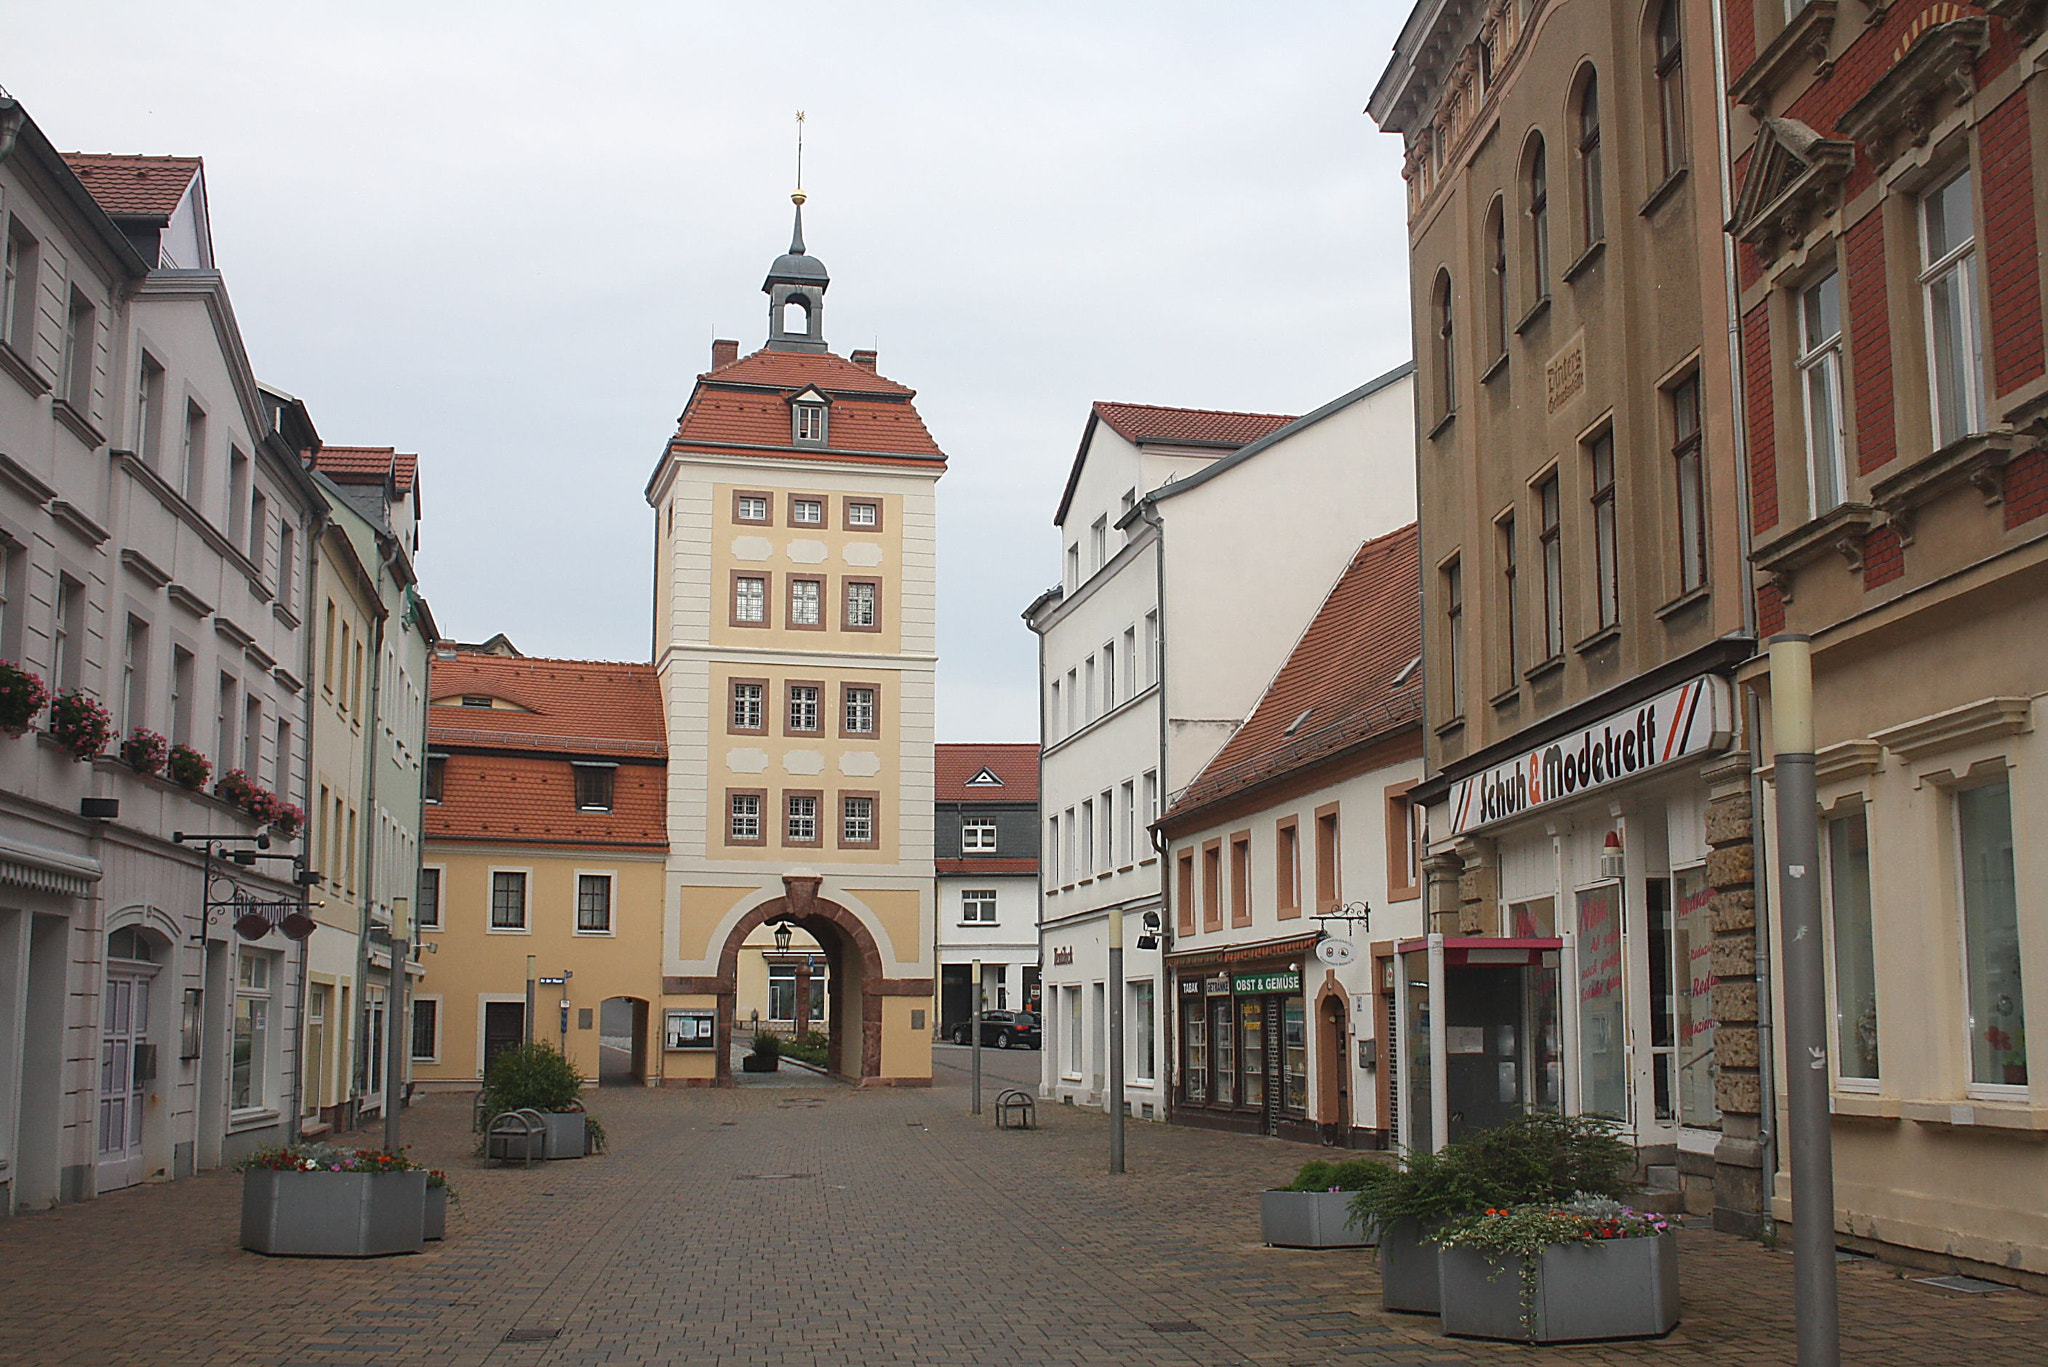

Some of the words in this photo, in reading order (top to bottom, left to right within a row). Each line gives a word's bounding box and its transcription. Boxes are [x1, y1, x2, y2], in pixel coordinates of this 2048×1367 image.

[1481, 761, 1526, 823] Schuh
[1529, 752, 1541, 805] &
[1543, 705, 1655, 801] Modetreff
[1183, 982, 1199, 993] TABAK
[1236, 979, 1256, 991] OBST
[1258, 978, 1264, 990] &
[1265, 974, 1300, 990] GEMÜSE
